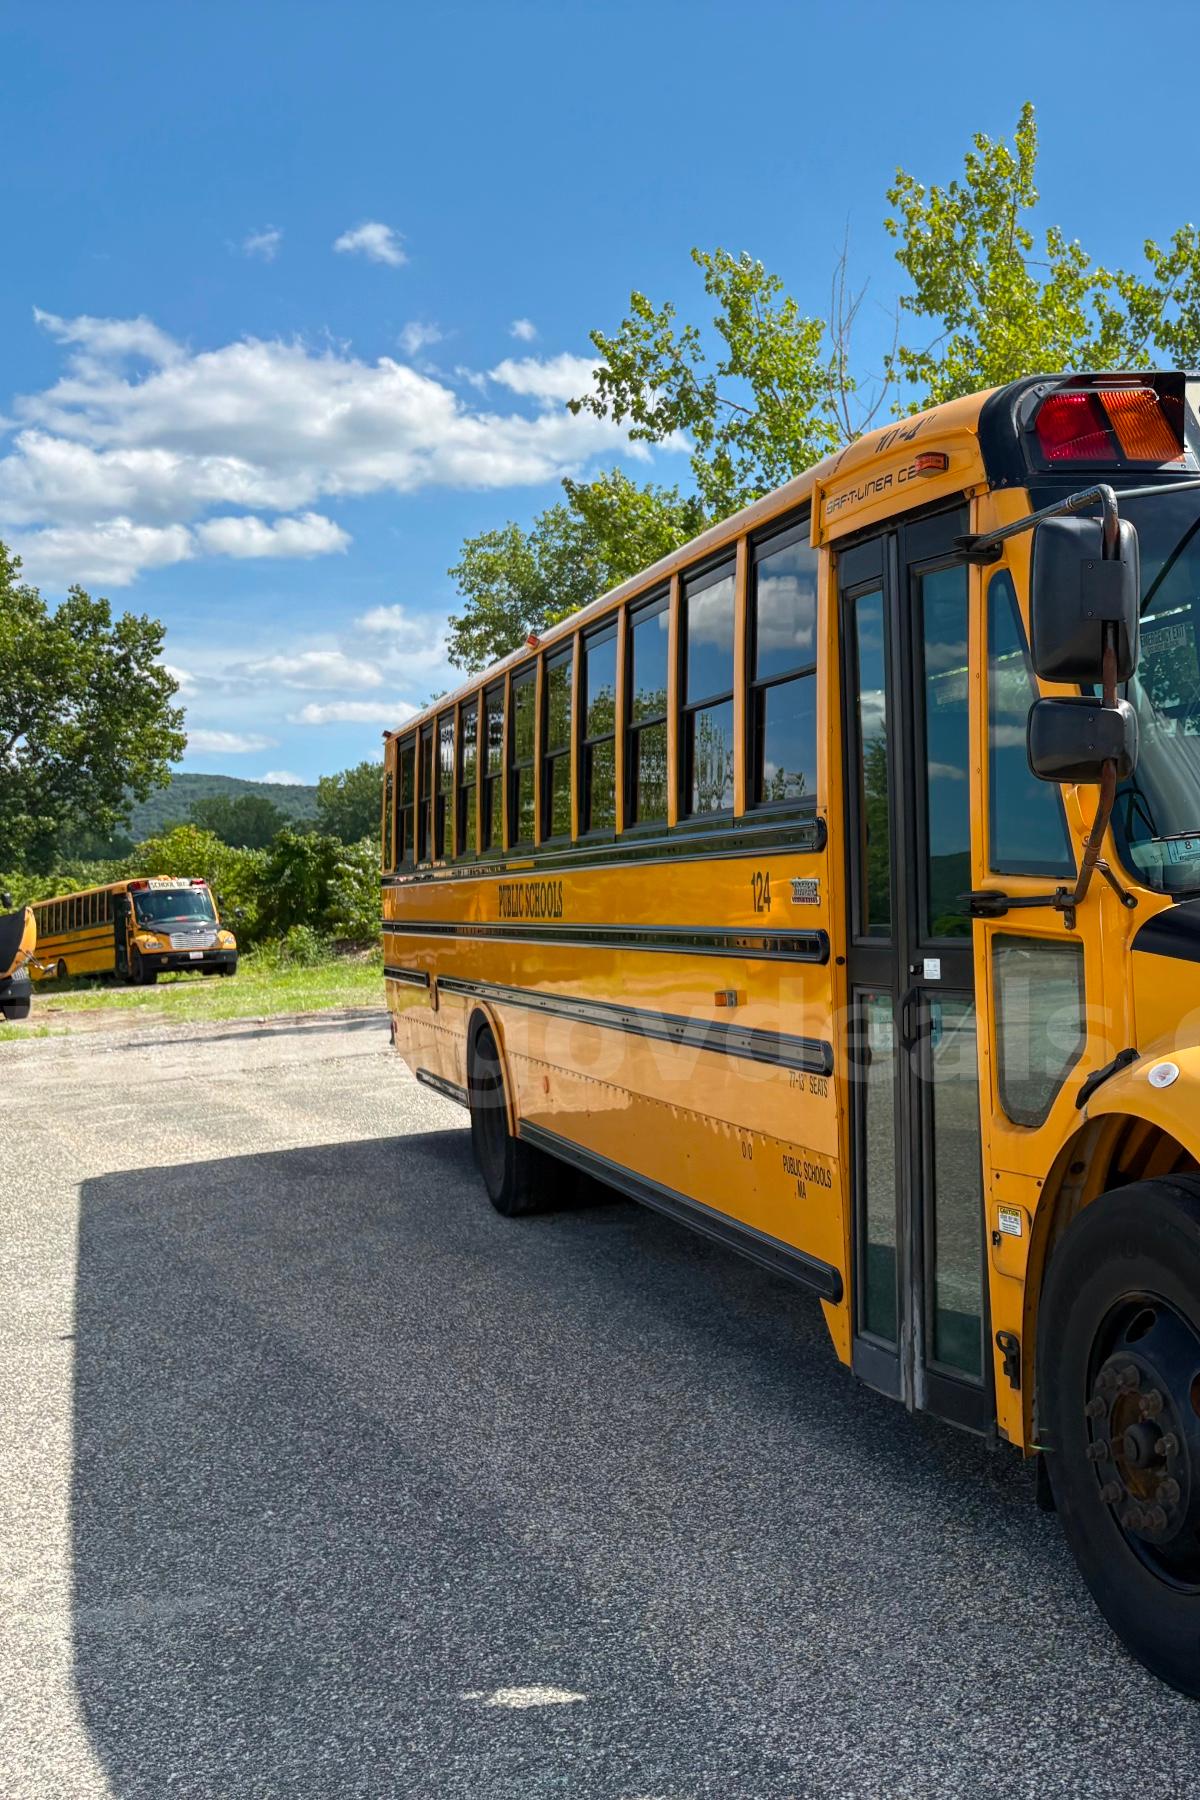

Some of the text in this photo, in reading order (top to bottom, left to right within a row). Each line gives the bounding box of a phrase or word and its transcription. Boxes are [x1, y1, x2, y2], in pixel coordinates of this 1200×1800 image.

[498, 881, 563, 918] PUBLIC SCHOOLS
[751, 872, 771, 913] 124
[810, 1075, 828, 1098] SEATS
[782, 1154, 832, 1189] PUBLIC SCHOOLS
